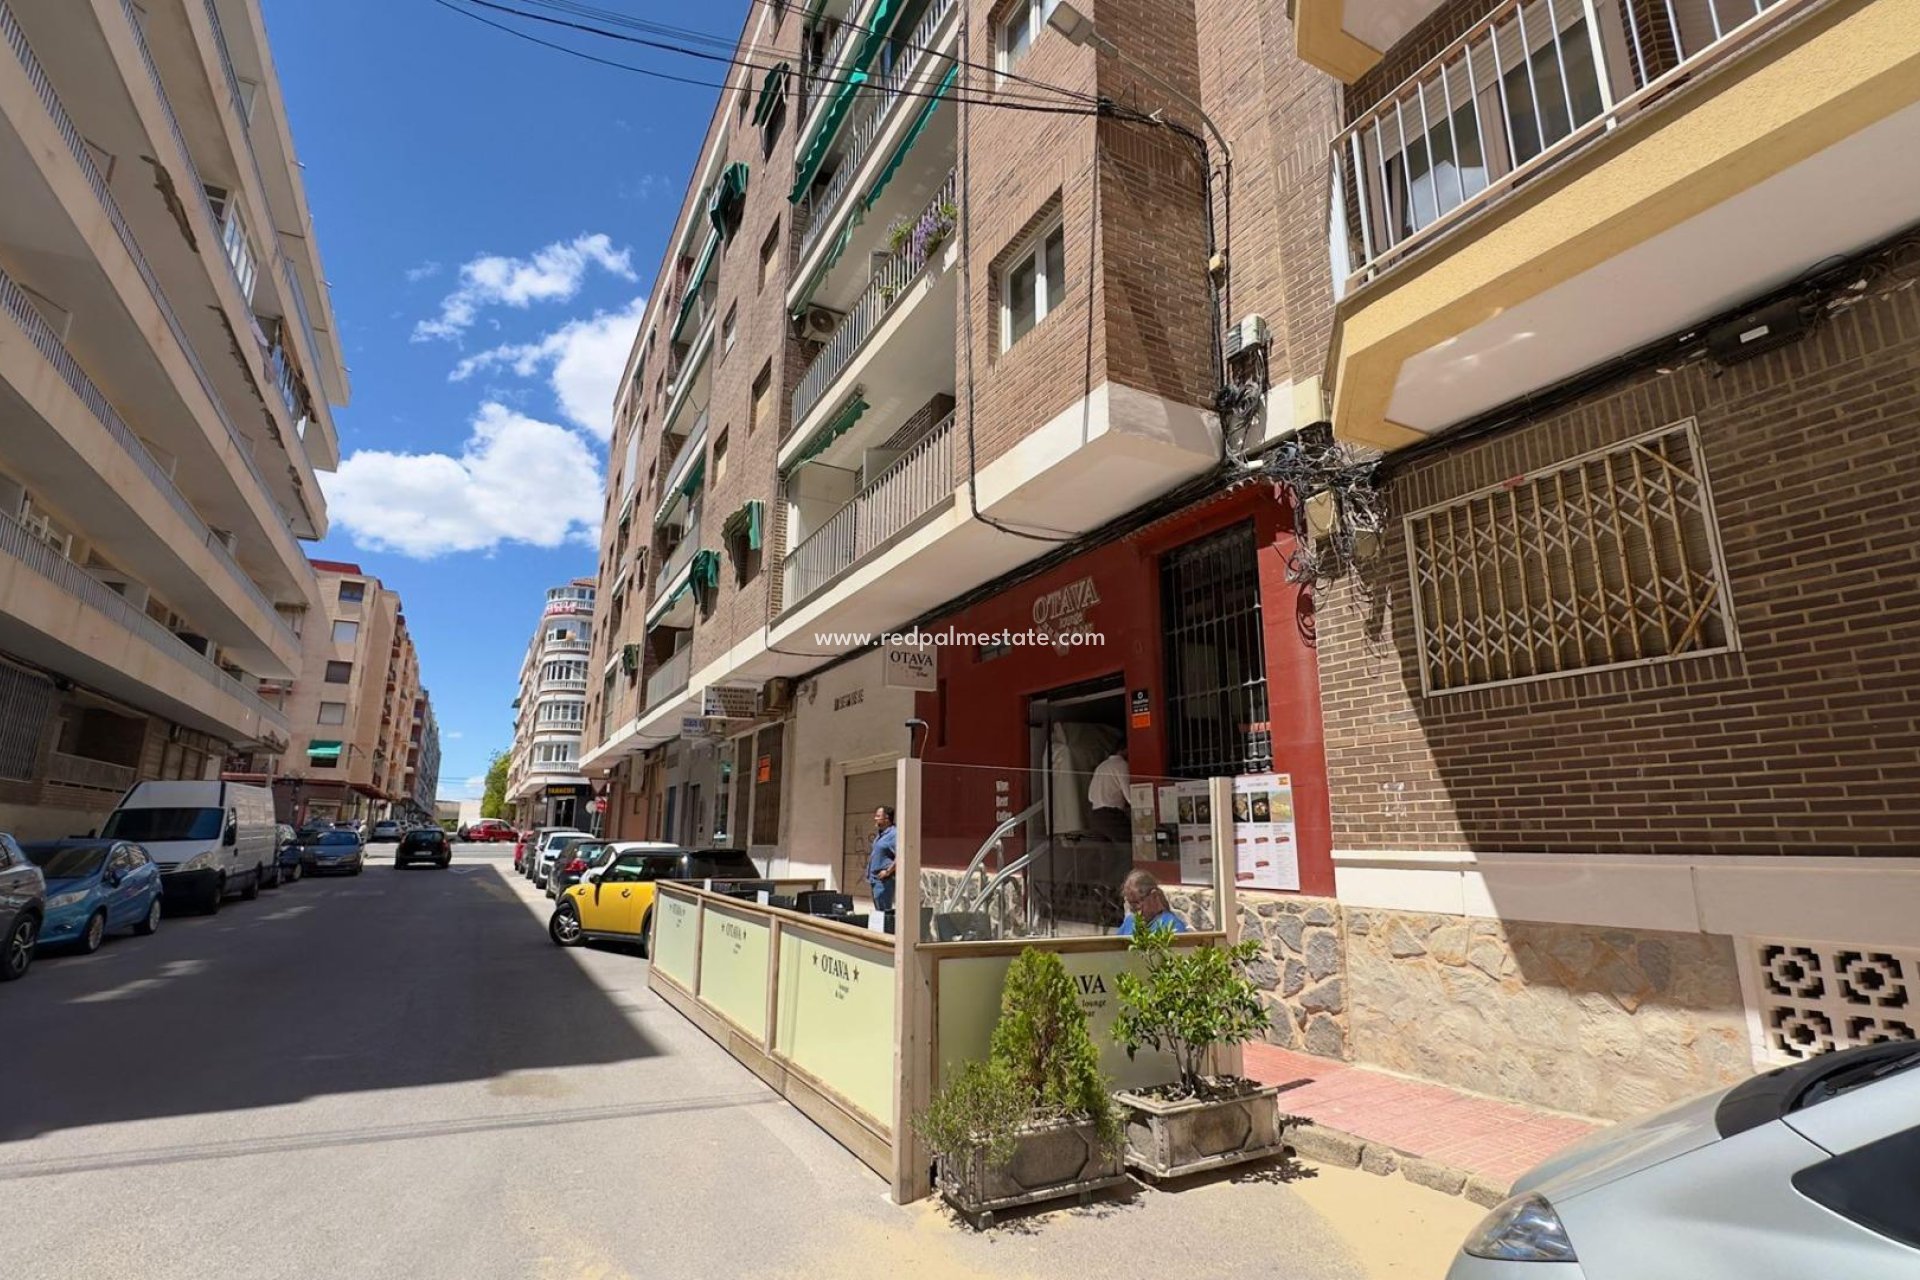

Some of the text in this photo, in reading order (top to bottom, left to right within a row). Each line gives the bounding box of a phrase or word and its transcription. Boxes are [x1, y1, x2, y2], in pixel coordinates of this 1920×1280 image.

[1033, 577, 1100, 624] OTAVA
[890, 650, 933, 666] OTAVA
[821, 953, 850, 981] OTAVA
[1072, 974, 1107, 995] AVA
